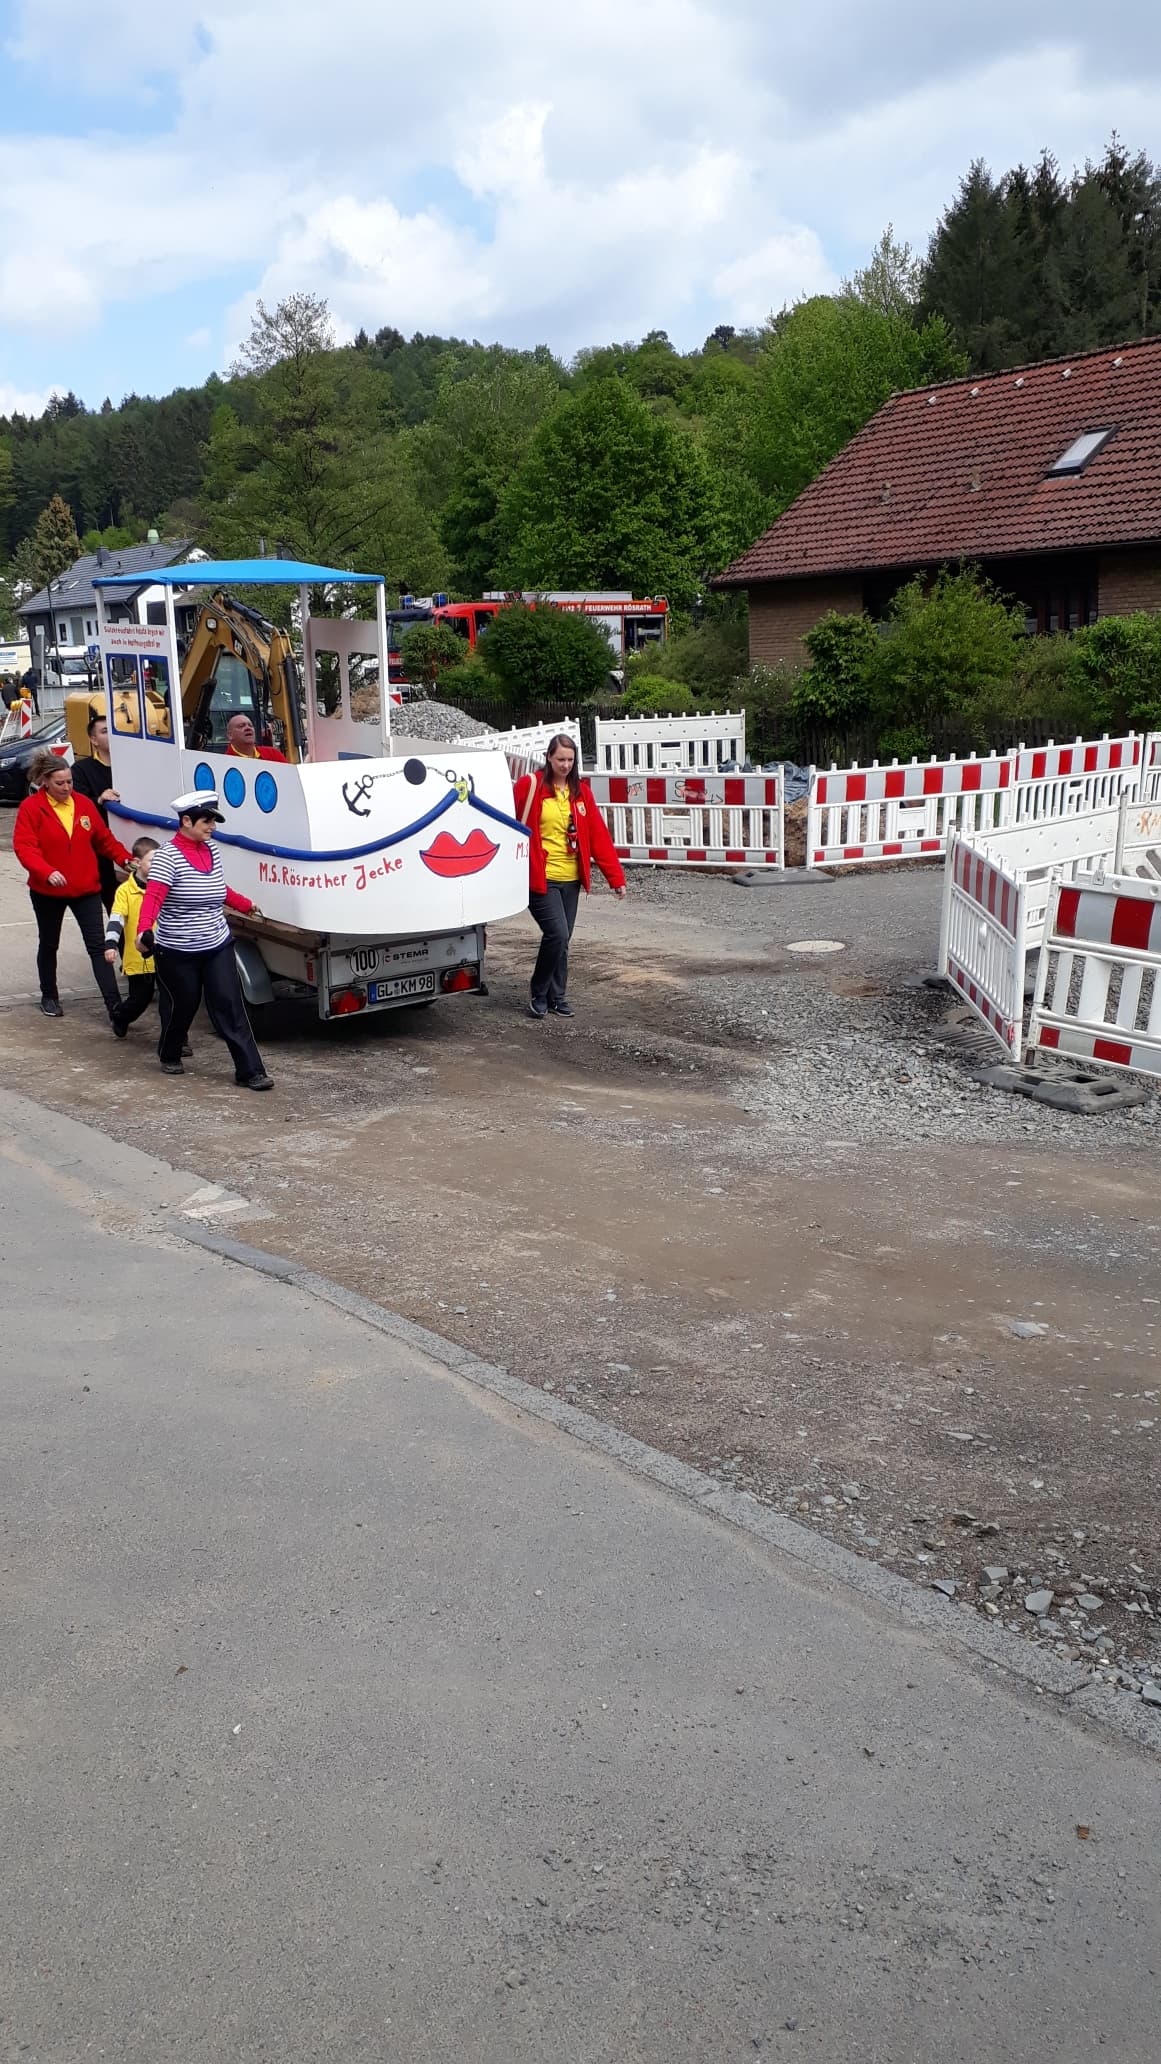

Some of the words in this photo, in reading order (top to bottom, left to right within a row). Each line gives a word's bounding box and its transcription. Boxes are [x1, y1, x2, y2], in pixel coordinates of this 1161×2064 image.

[585, 604, 622, 612] FEUERWEHR
[624, 603, 652, 612] RÖSRATH
[259, 862, 281, 883] M.S.
[282, 867, 348, 888] Rösrather
[353, 857, 403, 890] Jecke
[352, 949, 376, 971] 100
[392, 948, 429, 961] STEMA
[377, 984, 393, 998] GL
[401, 980, 417, 994] KM
[419, 975, 433, 989] 98
